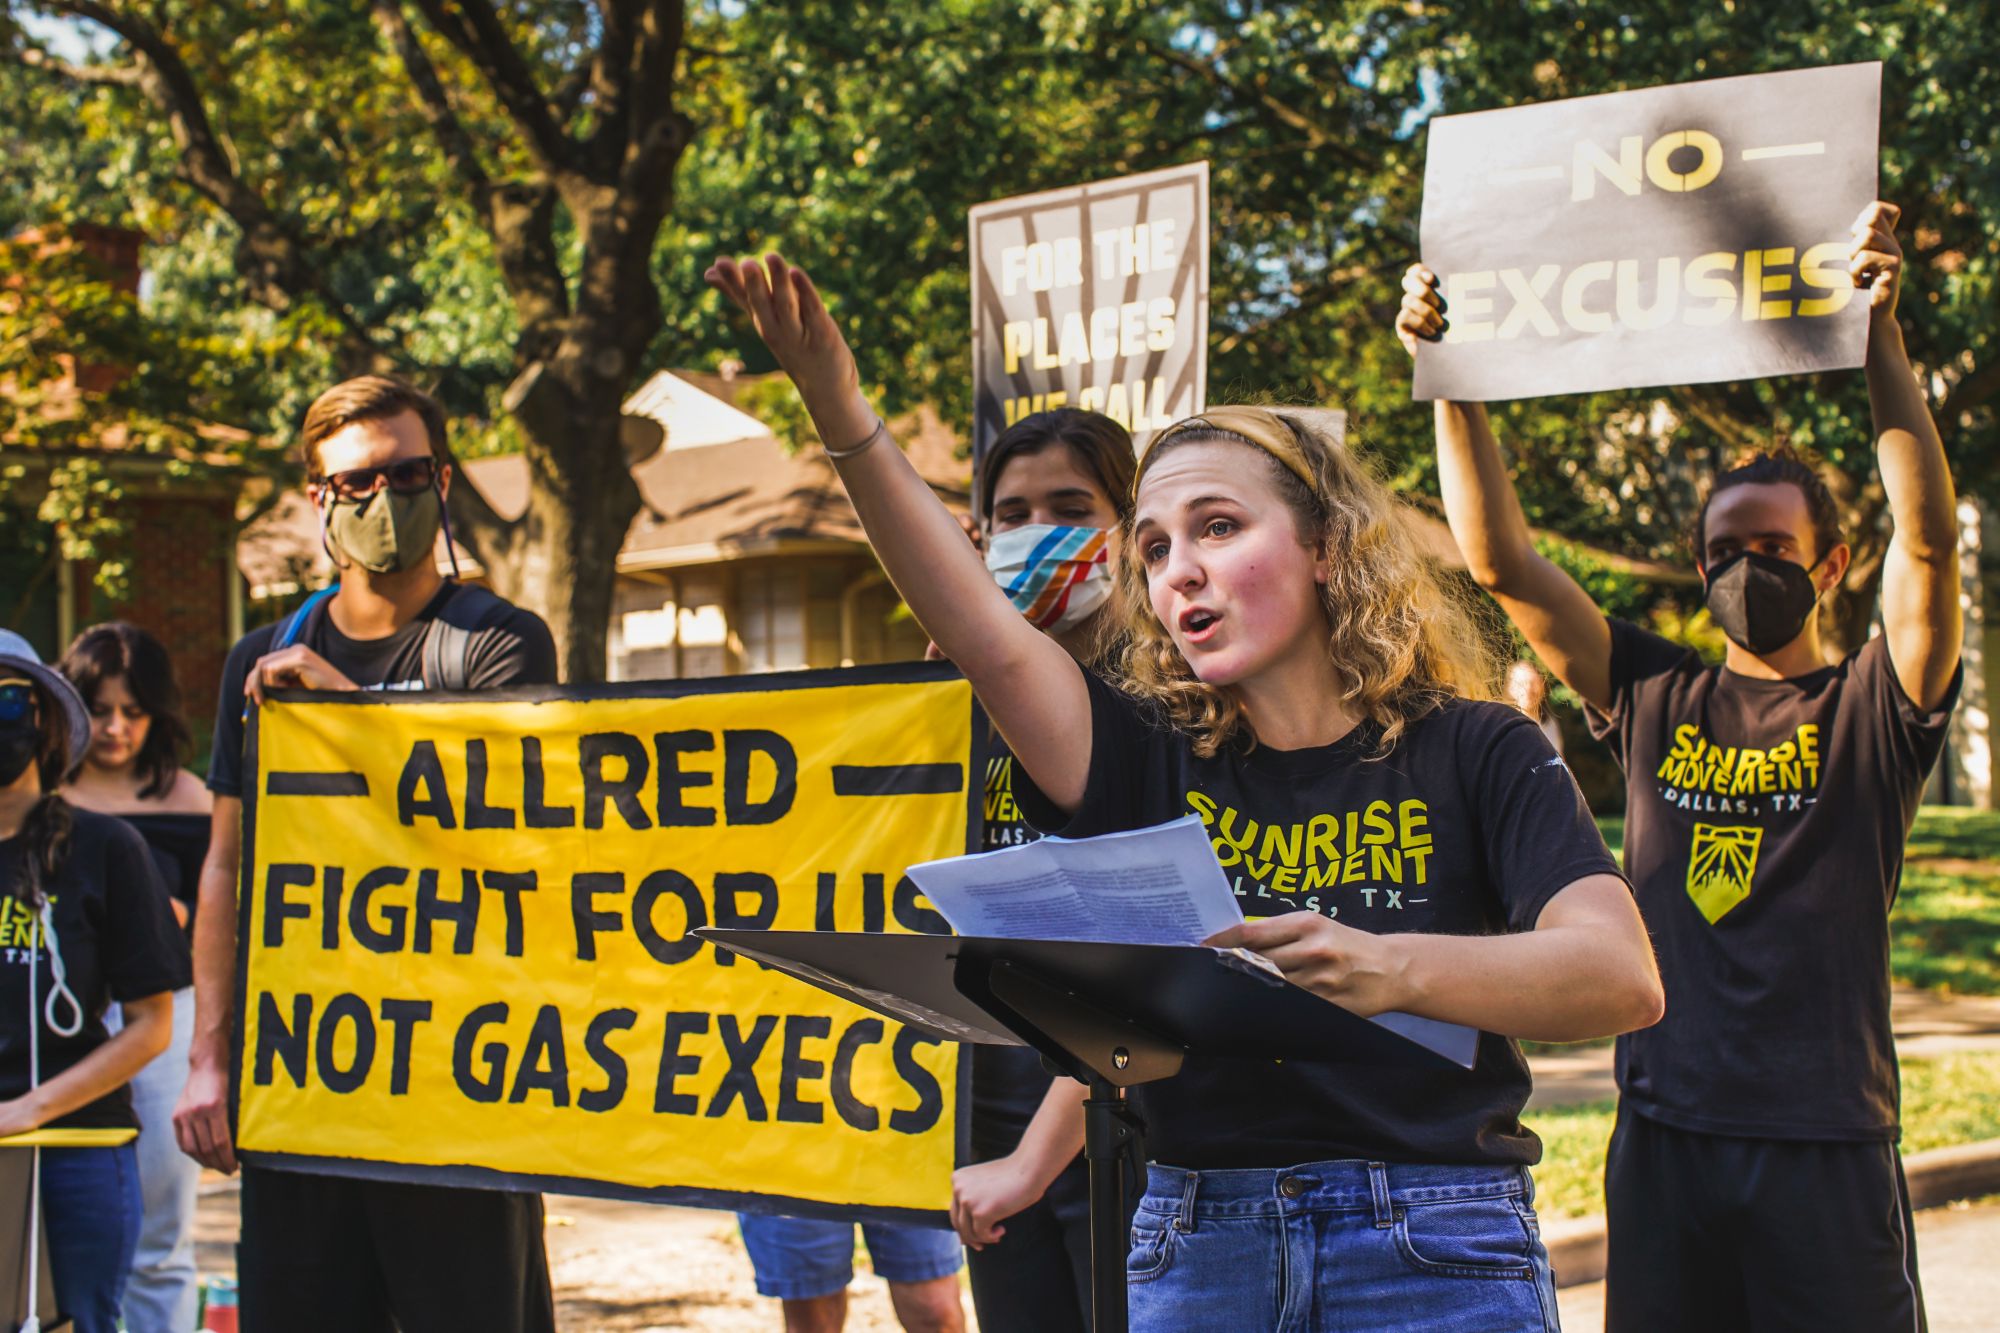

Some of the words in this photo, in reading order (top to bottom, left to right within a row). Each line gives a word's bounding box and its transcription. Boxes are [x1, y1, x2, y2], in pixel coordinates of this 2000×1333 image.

[1571, 129, 1724, 202] NO
[1001, 237, 1083, 296] FOR
[1093, 218, 1176, 280] THE
[1446, 242, 1854, 343] EXCUSES
[1004, 297, 1176, 374] PLACES
[397, 729, 798, 830] ALLRED
[1657, 757, 1819, 796] MOVEMENT
[1184, 790, 1433, 867] SUNRISE
[1206, 836, 1433, 894] OVEMENT
[263, 862, 538, 957] FIGHT
[571, 869, 779, 970] FOR
[254, 990, 432, 1096] NOT
[452, 1001, 638, 1113] GAS
[653, 1011, 943, 1135] EXECS
